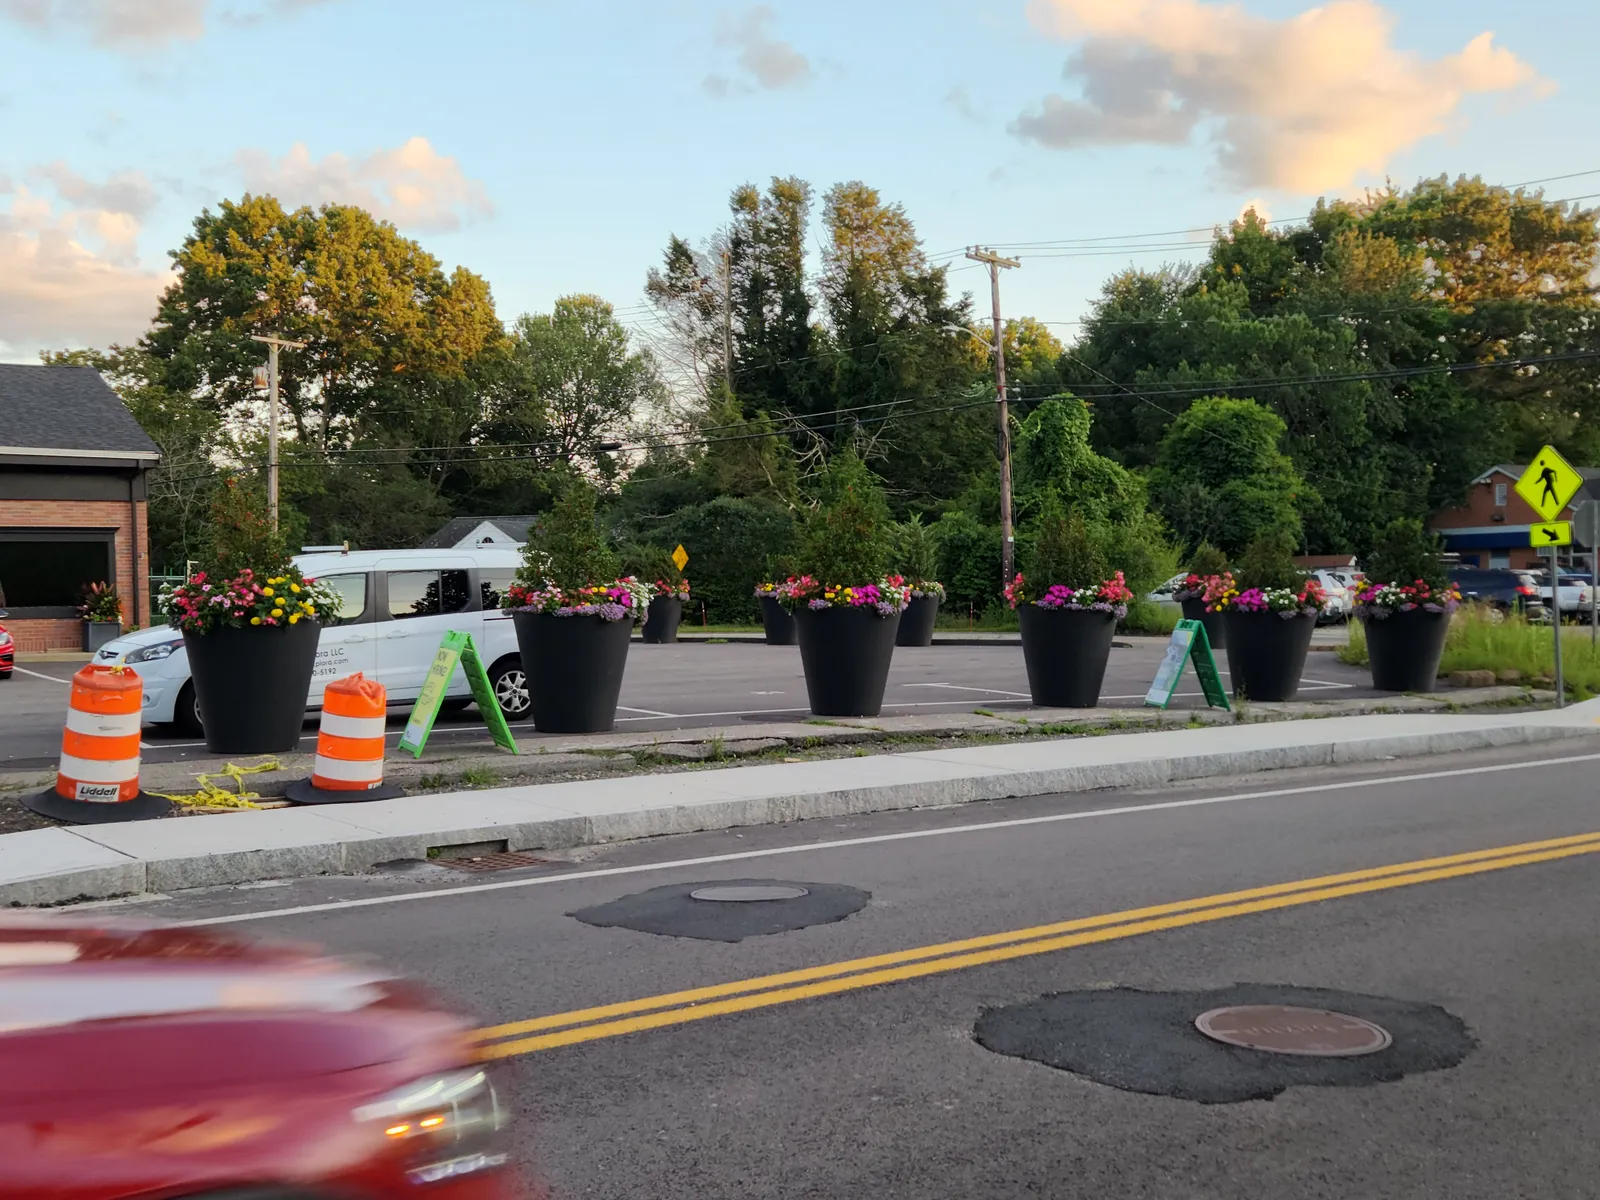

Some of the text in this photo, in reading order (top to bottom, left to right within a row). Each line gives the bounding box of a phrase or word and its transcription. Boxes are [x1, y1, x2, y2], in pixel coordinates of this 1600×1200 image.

[331, 648, 345, 656] LLC
[313, 658, 349, 667] plora.com
[80, 786, 118, 795] Liddell
